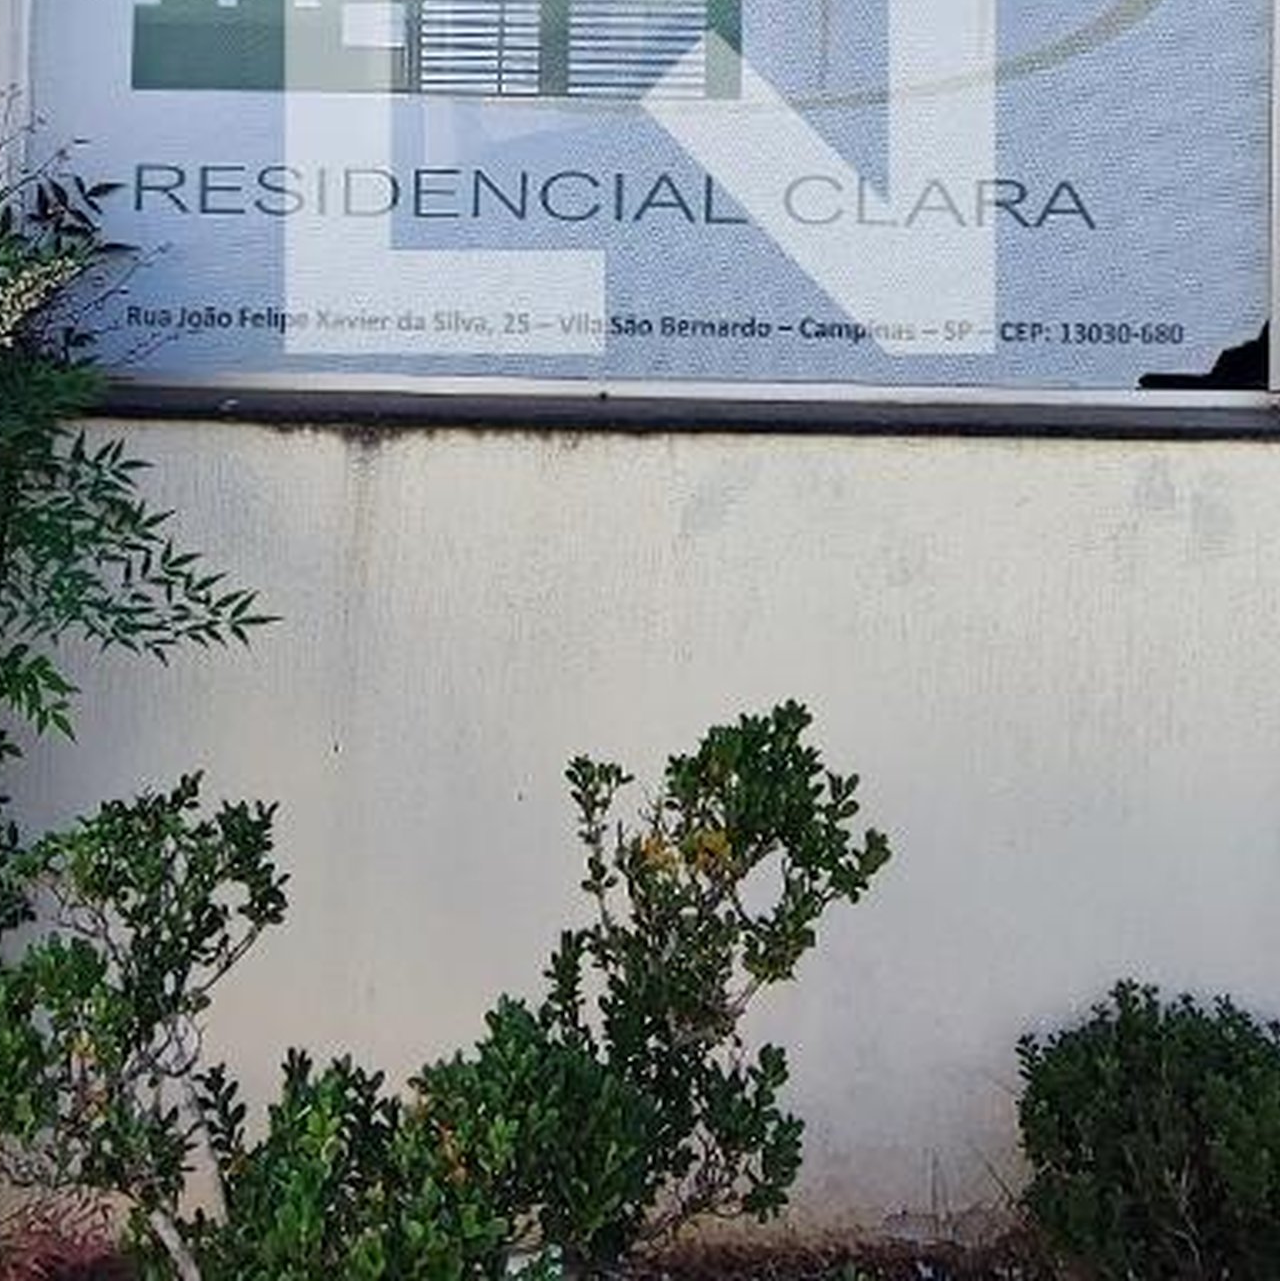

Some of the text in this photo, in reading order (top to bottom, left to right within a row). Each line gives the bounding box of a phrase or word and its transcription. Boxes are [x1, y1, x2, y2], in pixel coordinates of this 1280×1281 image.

[133, 163, 1096, 230] RESIDENCIAL CLARA
[126, 305, 172, 328] Rua
[179, 305, 233, 330] João
[239, 306, 310, 335] Felipe
[317, 309, 388, 332] Xavier
[397, 309, 426, 332] da
[433, 310, 494, 336] Silva,
[503, 312, 531, 336] 25
[558, 312, 602, 336] Vila
[610, 313, 653, 337] São
[660, 316, 771, 339] Bernardo
[799, 317, 914, 345] Campinas
[945, 321, 973, 342] SP
[1000, 322, 1051, 343] CEP:
[1060, 322, 1185, 345] 13030-680
